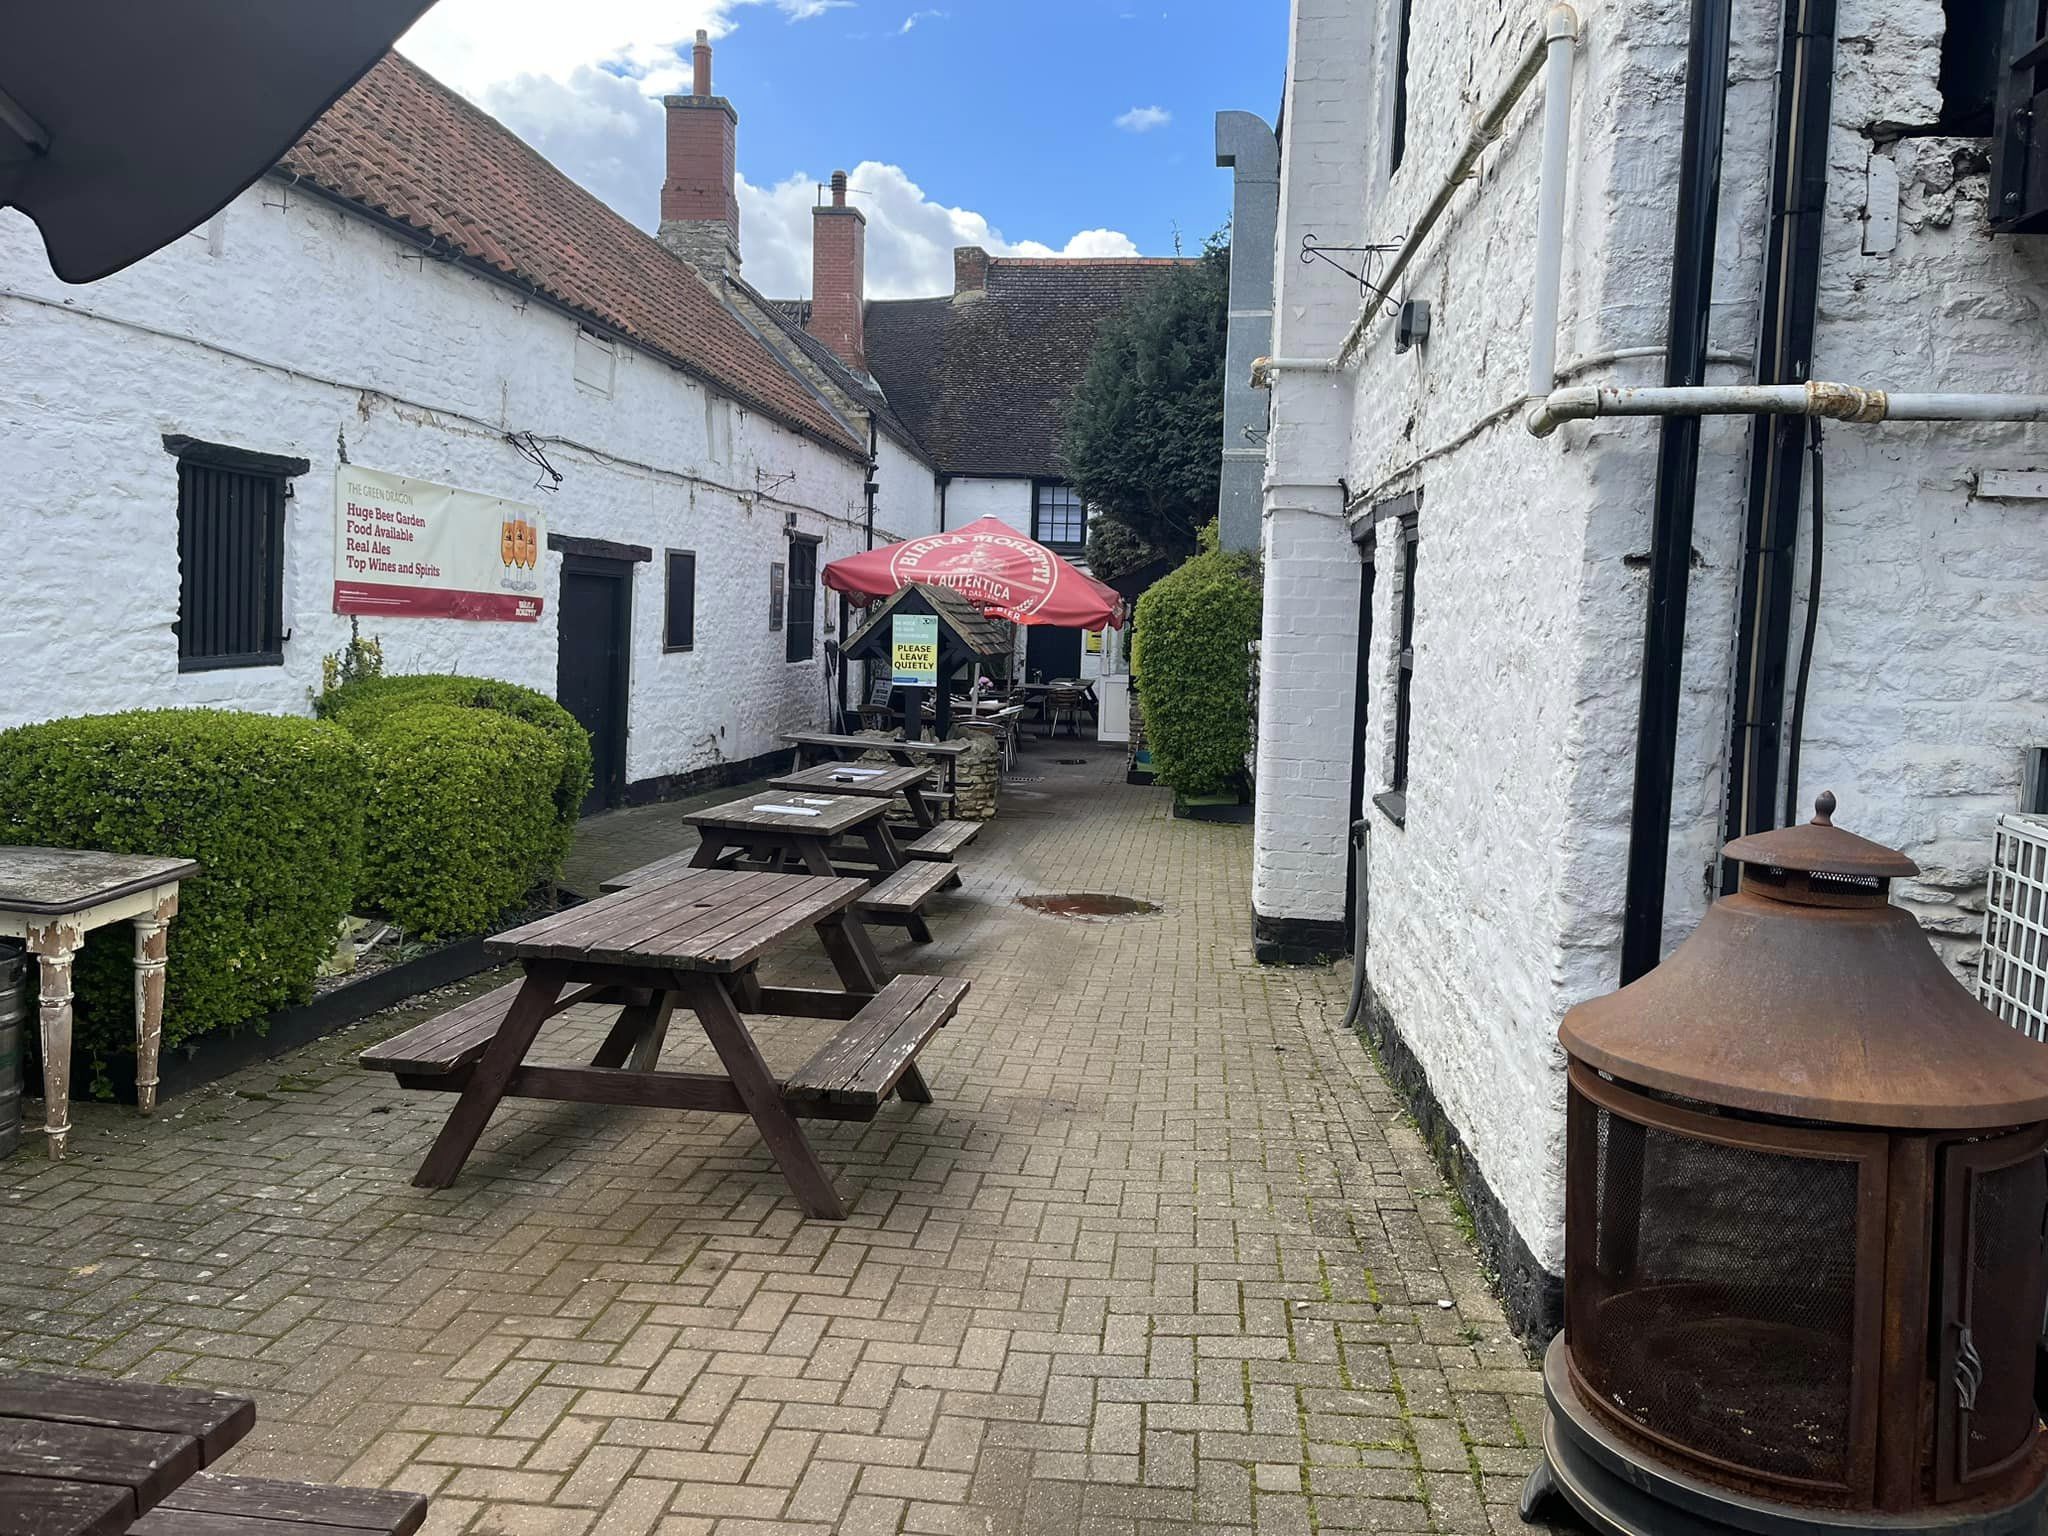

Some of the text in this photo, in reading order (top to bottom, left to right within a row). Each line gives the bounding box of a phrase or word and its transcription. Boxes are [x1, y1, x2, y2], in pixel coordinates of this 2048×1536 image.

[348, 482, 414, 506] THE GREEN DRAGON
[347, 502, 426, 528] Huge Beer Garden
[347, 520, 414, 542] Food Available
[346, 537, 391, 555] Real Ales
[346, 555, 441, 579] Top Wines and Spirits
[899, 534, 1050, 585] BIRRA MORETTI
[927, 574, 1010, 600] L'AUTENTICA
[897, 645, 932, 653] PLEASE
[900, 653, 929, 661] LEAVE
[894, 661, 934, 671] QUIETLY
